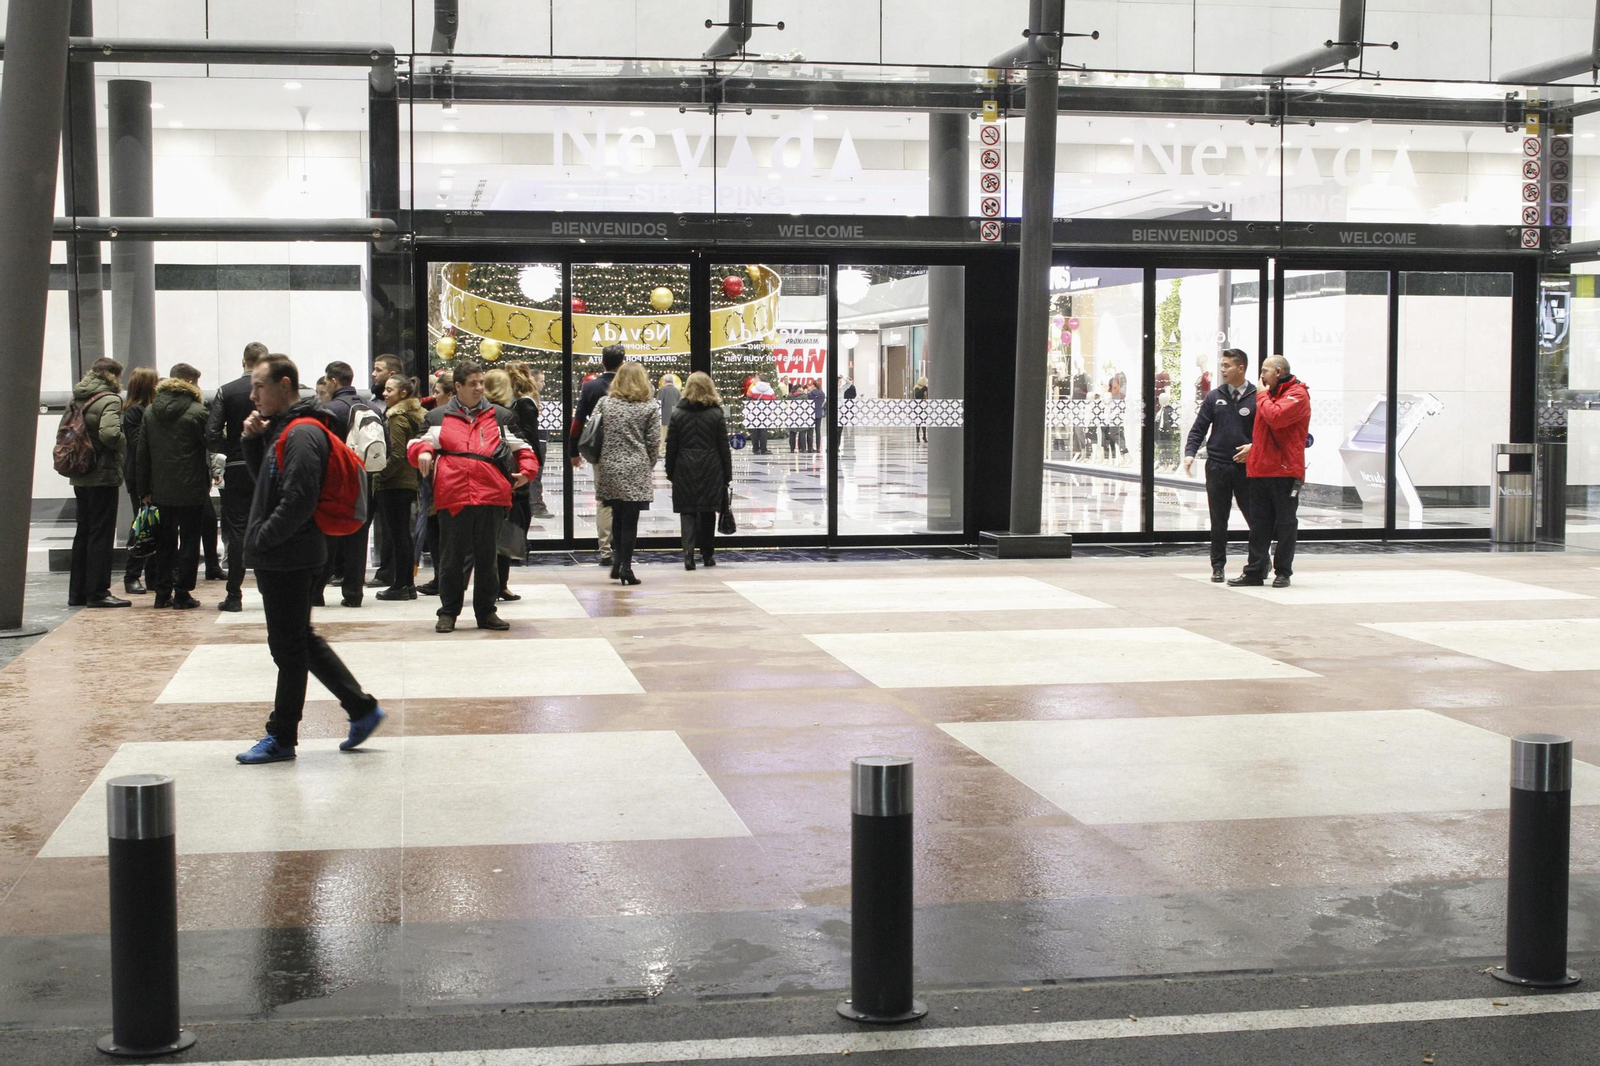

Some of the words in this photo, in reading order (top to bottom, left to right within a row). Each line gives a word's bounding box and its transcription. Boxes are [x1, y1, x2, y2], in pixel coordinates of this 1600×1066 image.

[551, 221, 668, 236] BIENVENIDOS
[778, 224, 864, 238] WELCOME
[1132, 228, 1238, 243] BIENVENIDOS
[1339, 231, 1417, 245] WELCOME
[772, 348, 826, 373] RAN
